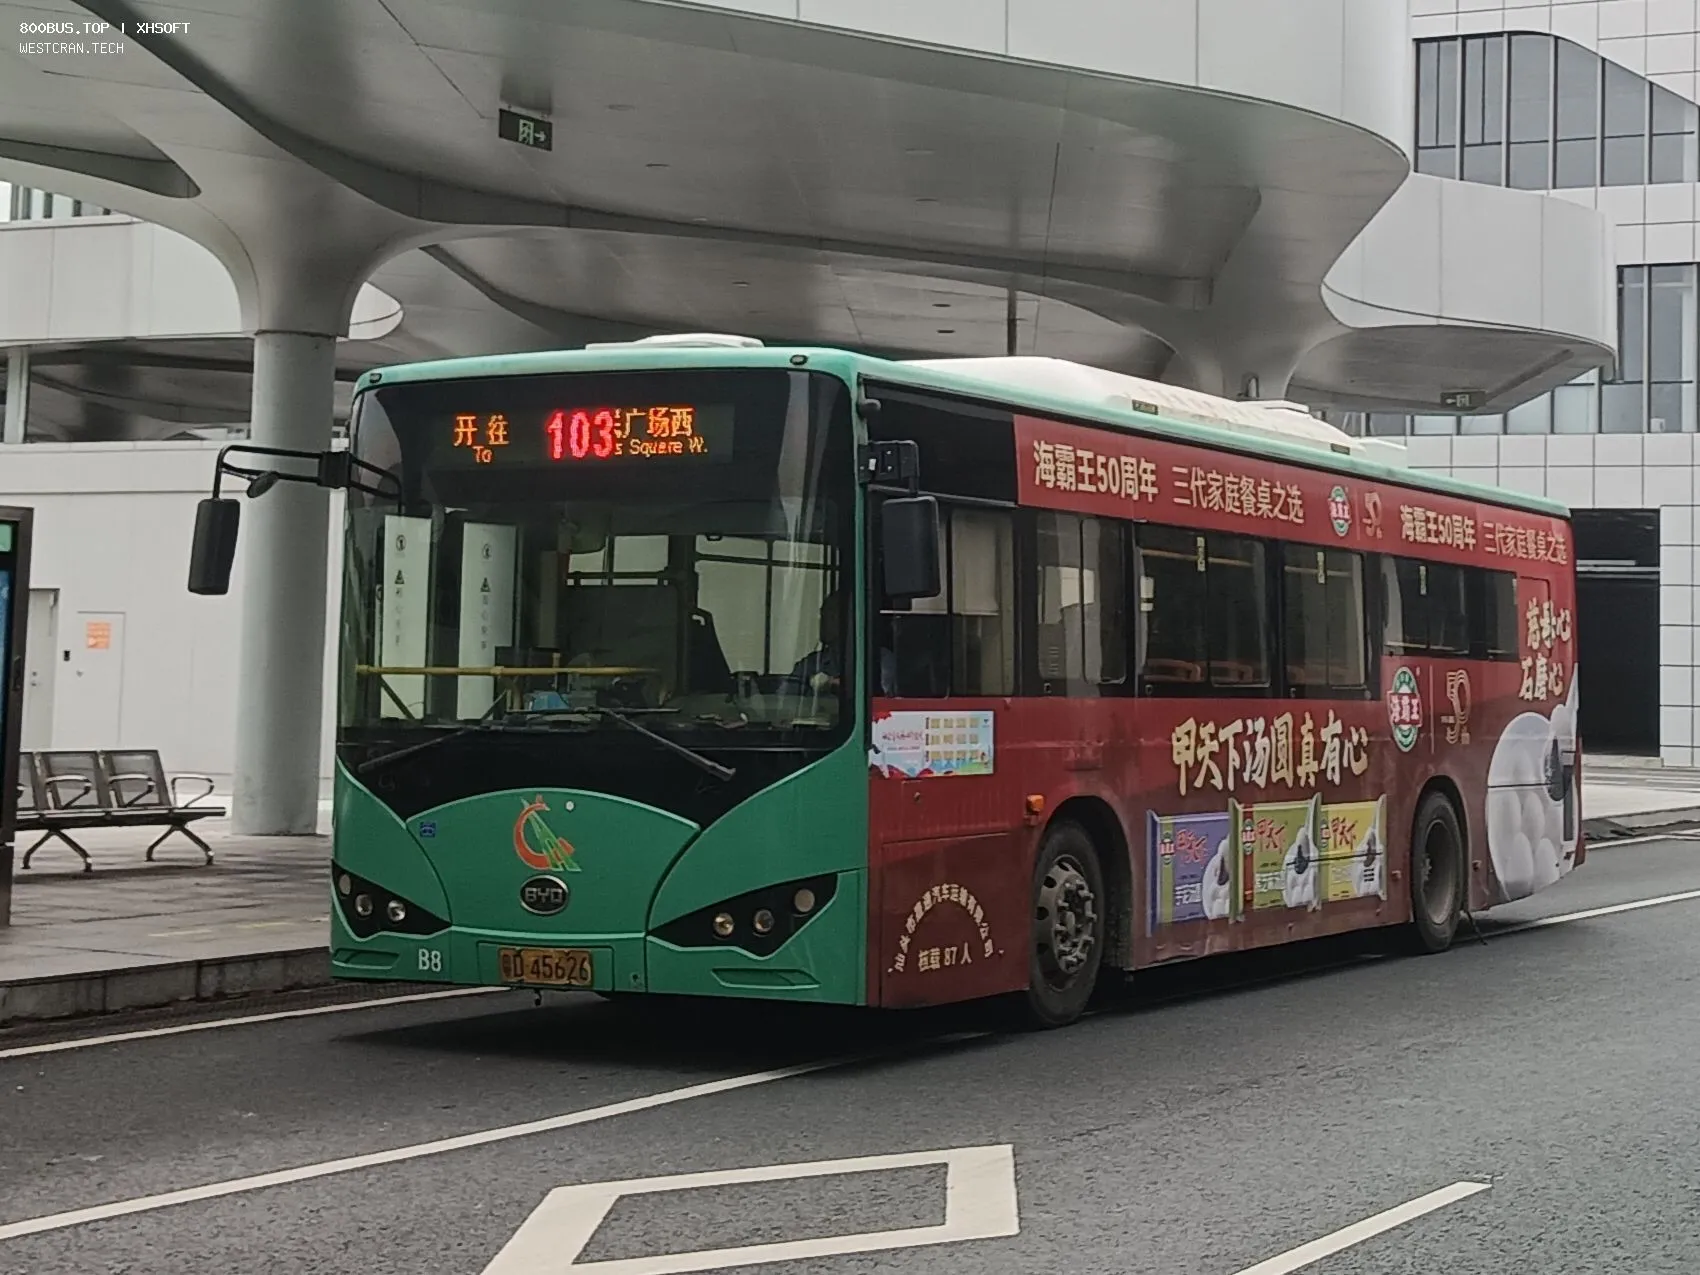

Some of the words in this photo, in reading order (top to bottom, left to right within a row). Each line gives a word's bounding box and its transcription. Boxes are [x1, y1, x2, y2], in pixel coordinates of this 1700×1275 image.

[453, 414, 510, 447] 开往
[546, 410, 614, 460] 103
[472, 445, 493, 464] To
[629, 438, 684, 458] Square
[1033, 440, 1159, 502] 海霸王50周年
[1171, 466, 1305, 524] 三代家庭餐桌之选
[1400, 504, 1477, 551] 海霸王50周年
[1483, 521, 1568, 565] 三代家庭餐桌之选
[524, 886, 564, 904] BYD
[417, 948, 442, 973] B8
